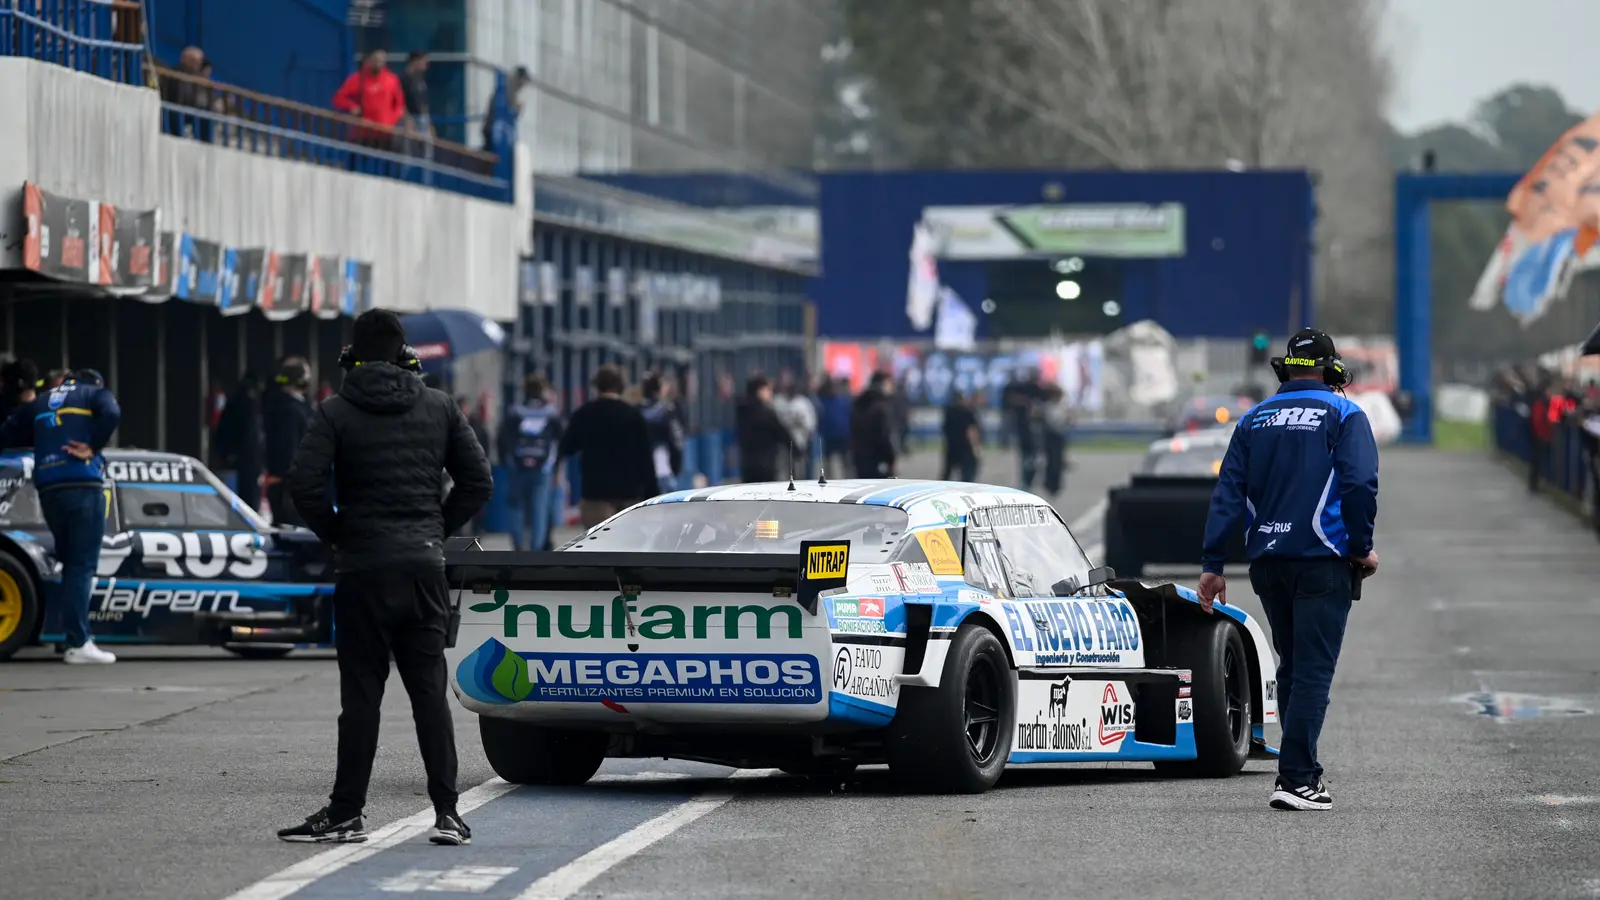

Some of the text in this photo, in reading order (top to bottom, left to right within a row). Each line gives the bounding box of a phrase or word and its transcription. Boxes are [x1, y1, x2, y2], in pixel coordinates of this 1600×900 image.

[1284, 357, 1316, 366] DAVICOM
[1274, 522, 1292, 533] RUS
[140, 532, 268, 578] RUS
[809, 550, 845, 573] NITRAP
[89, 577, 254, 619] Halpern
[88, 612, 123, 621] RUPO
[836, 603, 857, 613] PUMA
[503, 595, 804, 640] nufarm
[838, 620, 871, 633] BONIFACIO
[1002, 601, 1139, 651] EL NUEVO FARO
[855, 648, 881, 669] FAVIO
[1035, 652, 1120, 665] Ingeniería y Construcción
[526, 659, 813, 685] MEGAPHOS
[540, 685, 815, 698] FERTILIZANTES PREMIUM EN SOLUCIÓN
[1052, 707, 1081, 750] alonso
[312, 817, 330, 832] EA7
